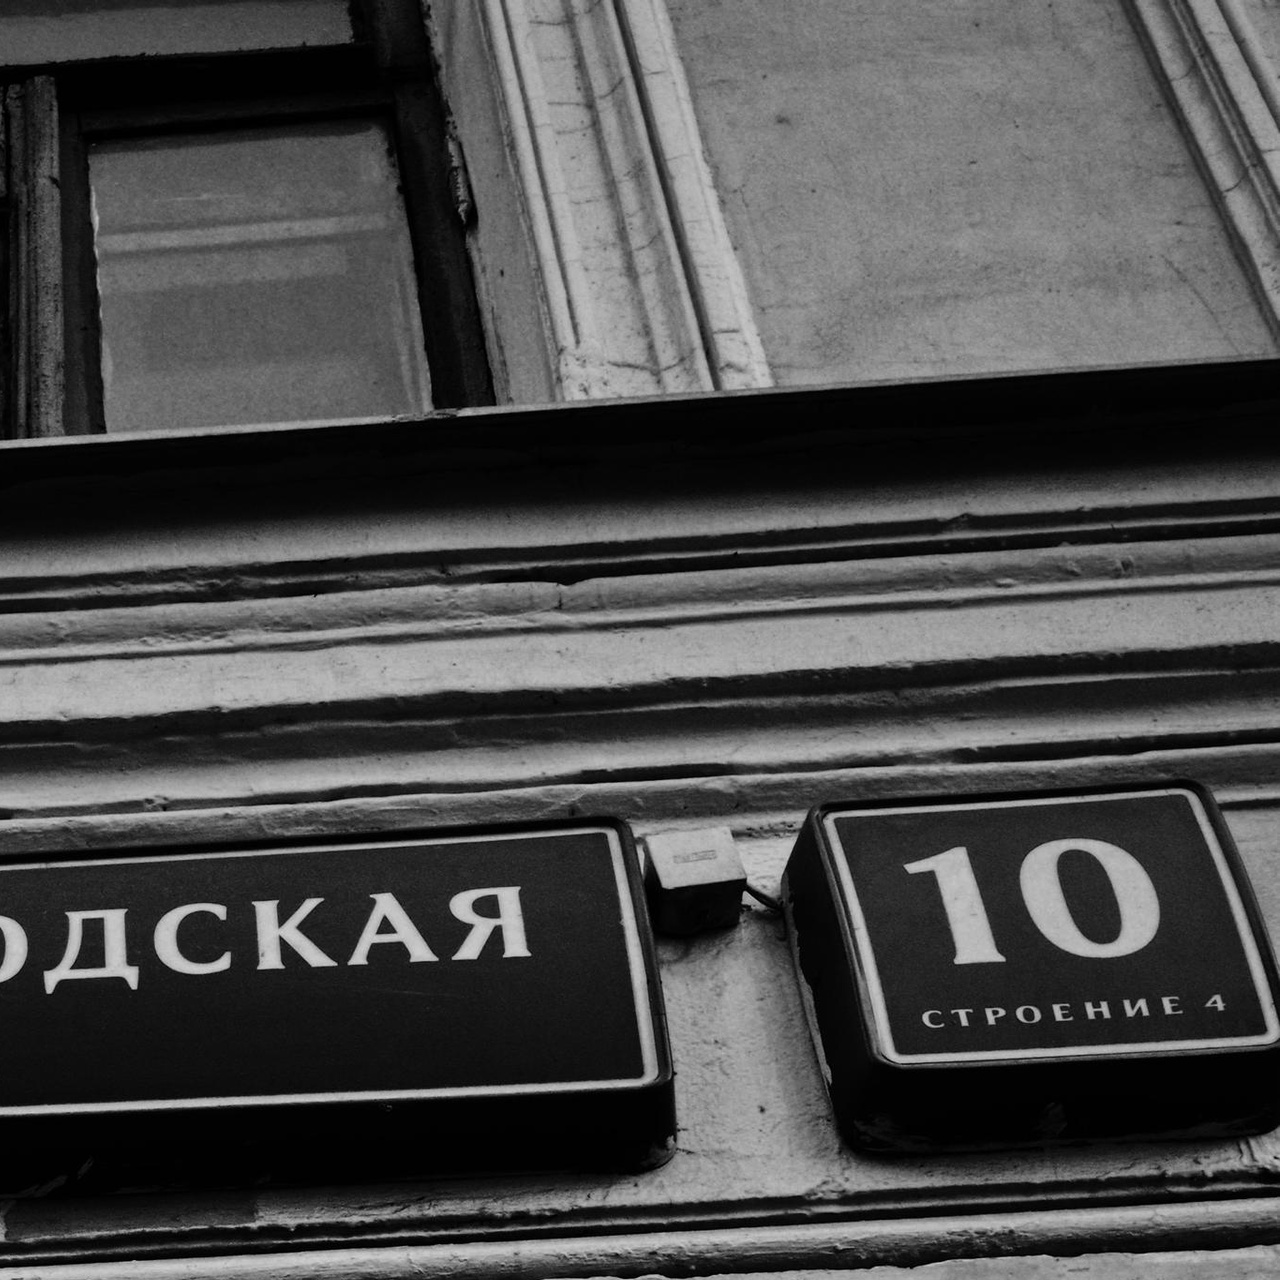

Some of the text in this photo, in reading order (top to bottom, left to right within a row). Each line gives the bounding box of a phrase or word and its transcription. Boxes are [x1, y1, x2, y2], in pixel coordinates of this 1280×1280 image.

[902, 837, 1162, 965] 10
[921, 993, 1227, 1029] СТРОЕНИЕ 4
